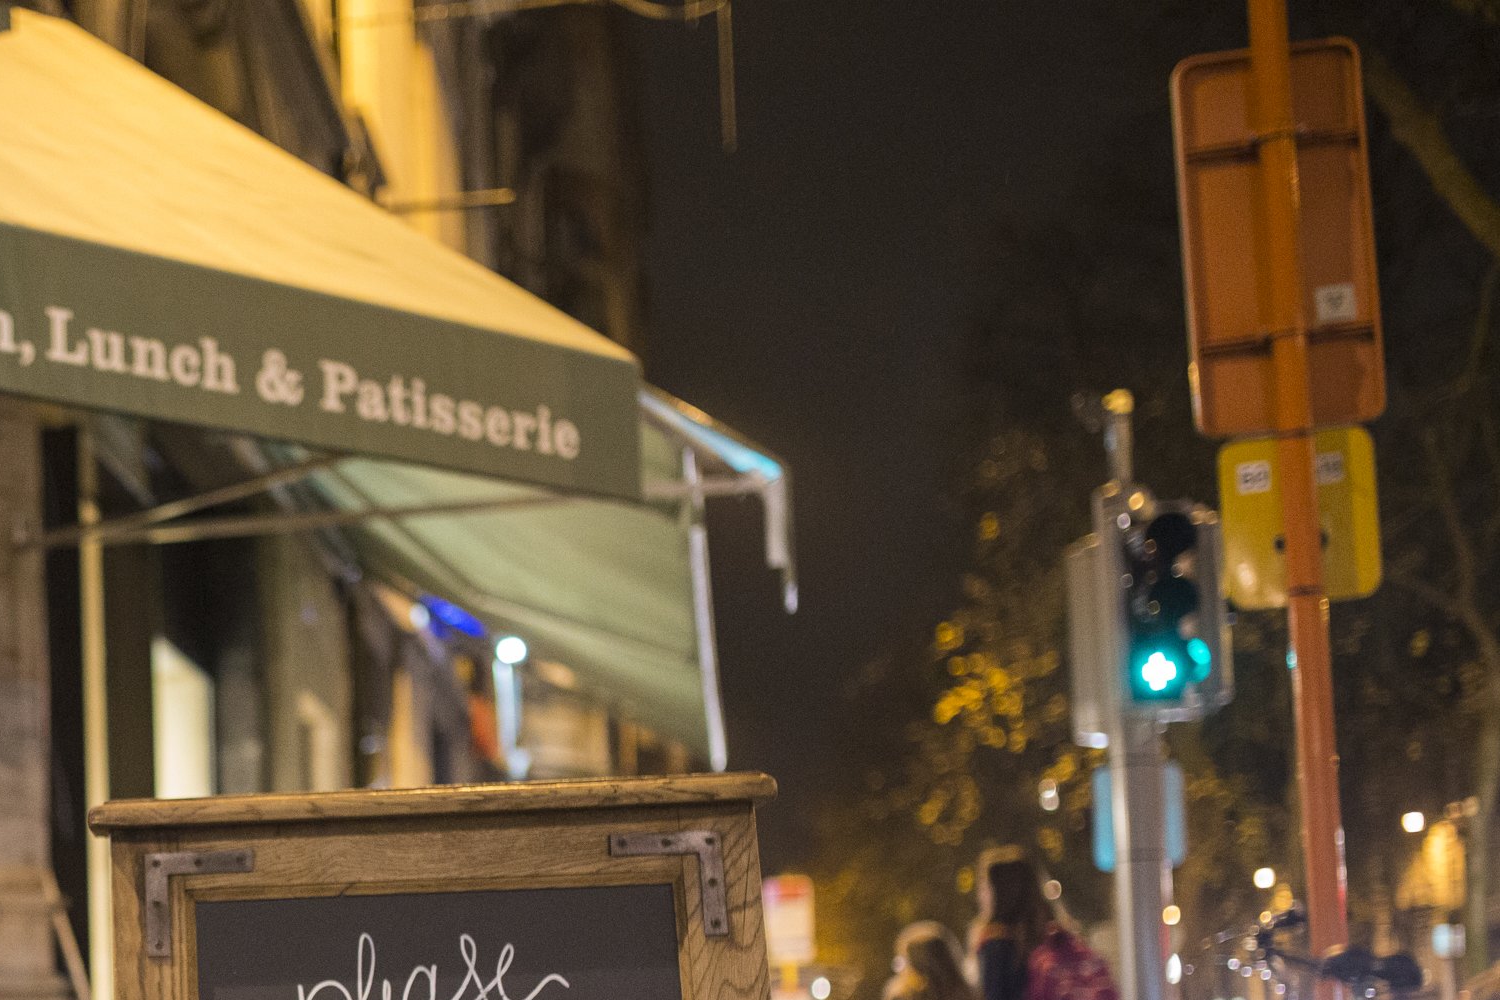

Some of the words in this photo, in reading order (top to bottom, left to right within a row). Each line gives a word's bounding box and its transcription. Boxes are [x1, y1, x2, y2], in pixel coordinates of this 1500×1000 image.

[44, 306, 240, 395] Lunch
[255, 349, 304, 405] &
[318, 359, 581, 461] Patisserie
